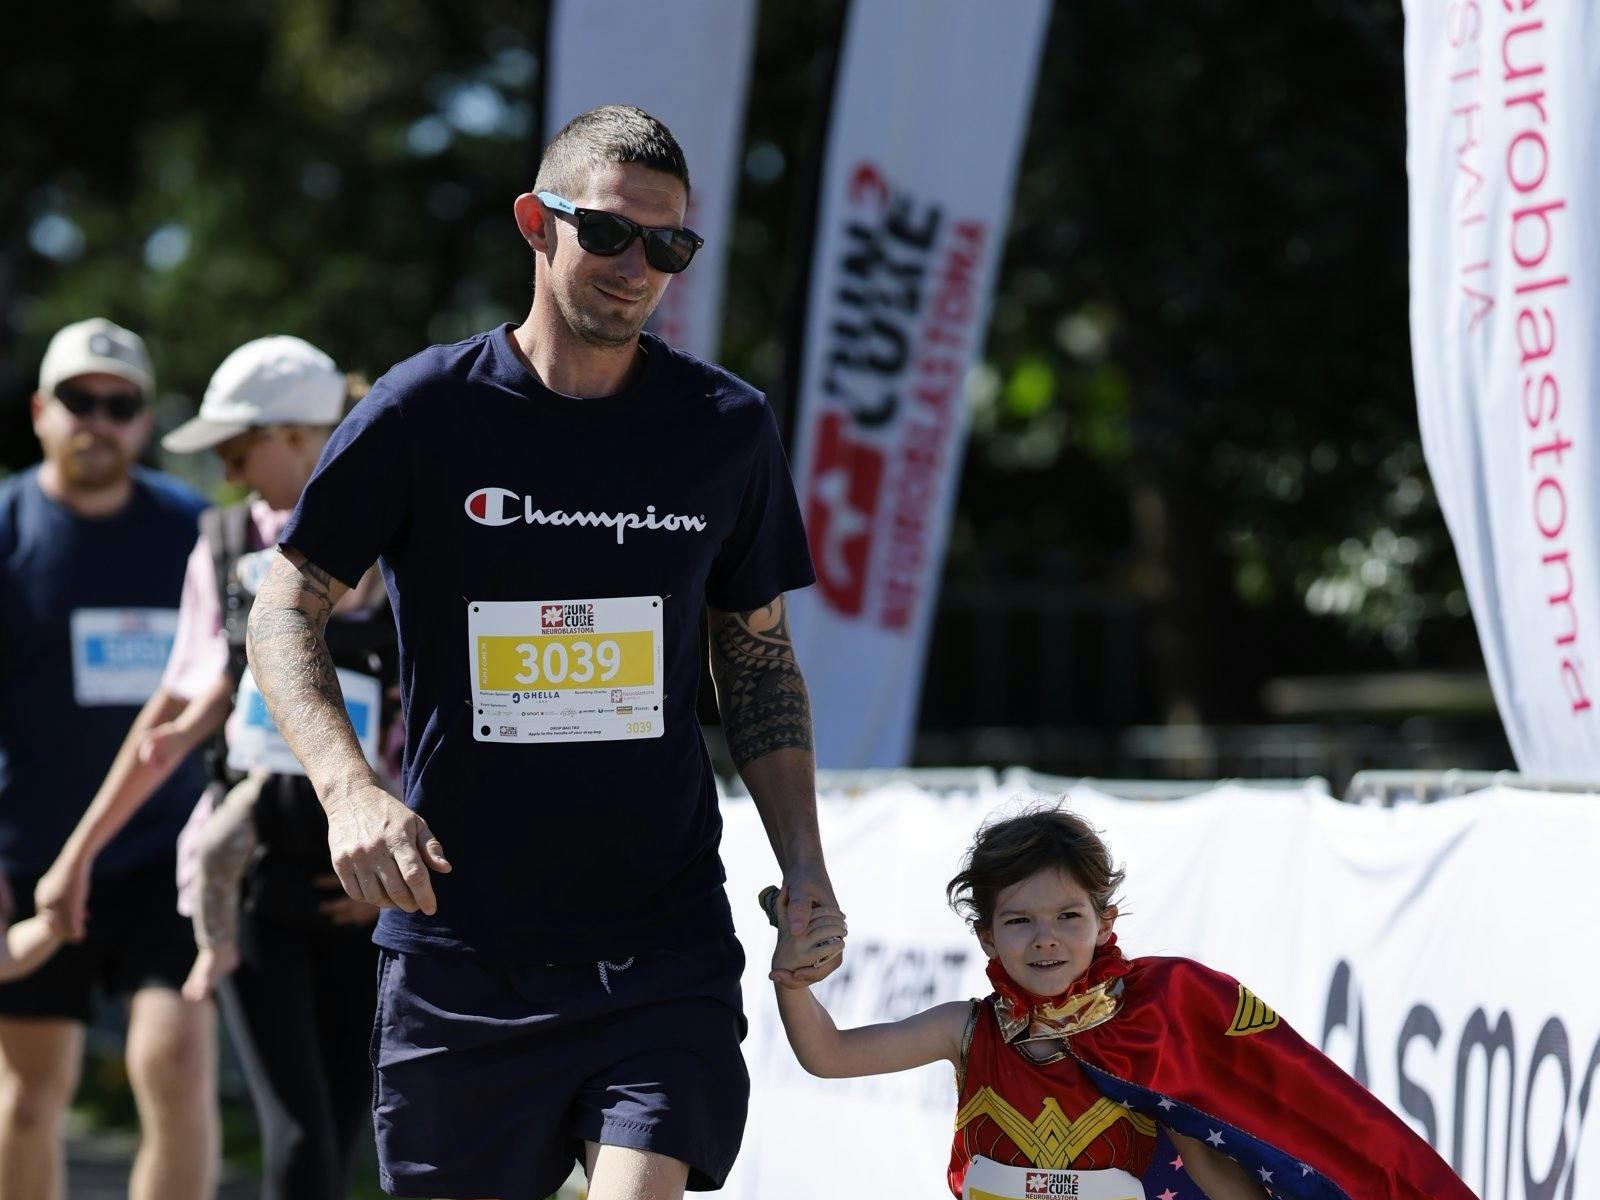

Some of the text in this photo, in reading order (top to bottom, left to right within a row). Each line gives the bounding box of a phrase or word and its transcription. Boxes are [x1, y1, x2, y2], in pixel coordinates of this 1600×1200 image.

[1501, 0, 1592, 716] uroblastoma
[464, 487, 707, 544] Champion
[564, 603, 594, 615] RUN2
[564, 615, 594, 627] CURE
[541, 627, 594, 635] NEUROBLASTOMA
[514, 640, 621, 684] 3039
[523, 691, 560, 699] GHELLA
[626, 721, 652, 734] 3039
[1049, 1173, 1079, 1184] RUN2
[1048, 1184, 1079, 1195] CURE
[1025, 1193, 1078, 1200] NEUROBLASTOMA
